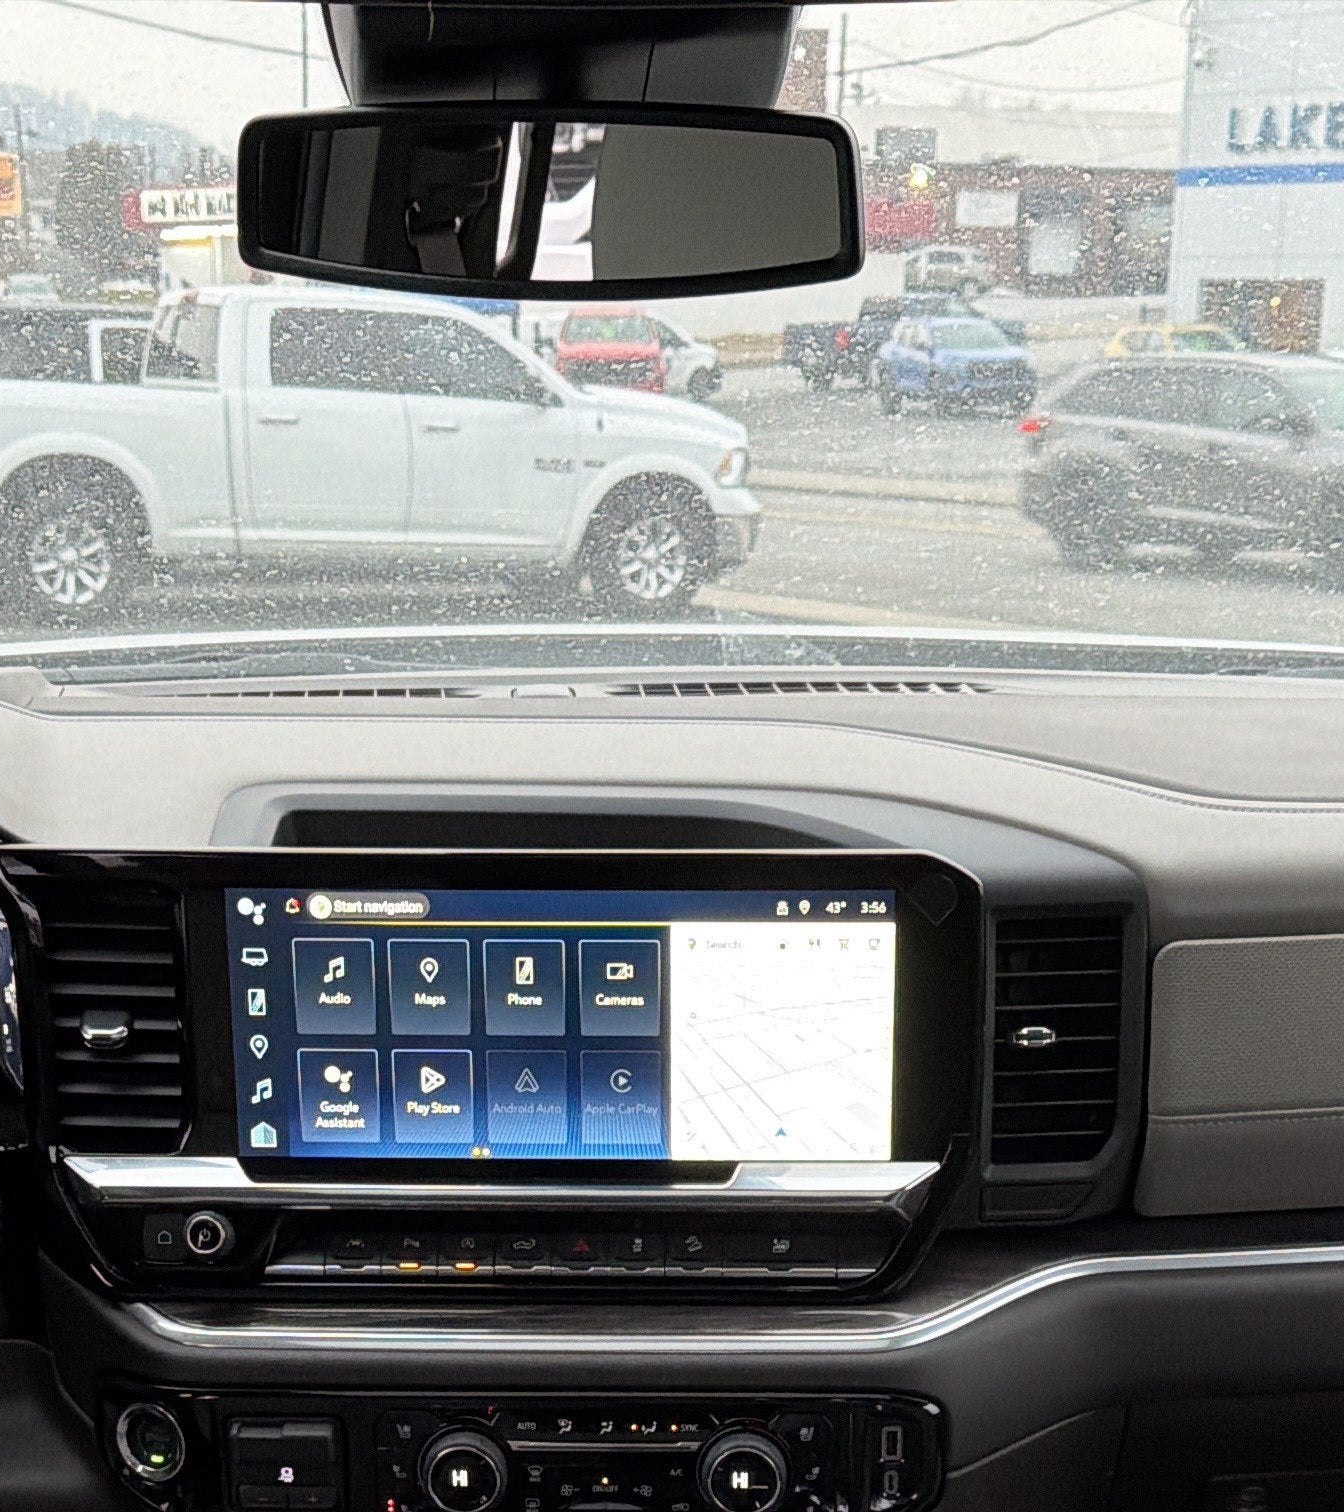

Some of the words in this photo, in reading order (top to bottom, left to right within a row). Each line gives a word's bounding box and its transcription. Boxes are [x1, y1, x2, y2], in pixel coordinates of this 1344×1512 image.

[334, 900, 362, 913] Start
[364, 900, 424, 916] navigation
[860, 901, 887, 914] 3:56
[318, 992, 352, 1005] Audio
[414, 992, 447, 1008] Maps
[507, 993, 543, 1006] Phone
[595, 993, 645, 1007] Cameras
[319, 1101, 360, 1116] Google
[407, 1101, 430, 1117] Play
[431, 1101, 461, 1114] Store
[492, 1103, 535, 1114] Android
[536, 1103, 562, 1114] Auto
[585, 1104, 616, 1115] Apple
[618, 1103, 659, 1116] CarPlay
[314, 1116, 366, 1129] Assistant
[517, 1421, 537, 1430] AUTO
